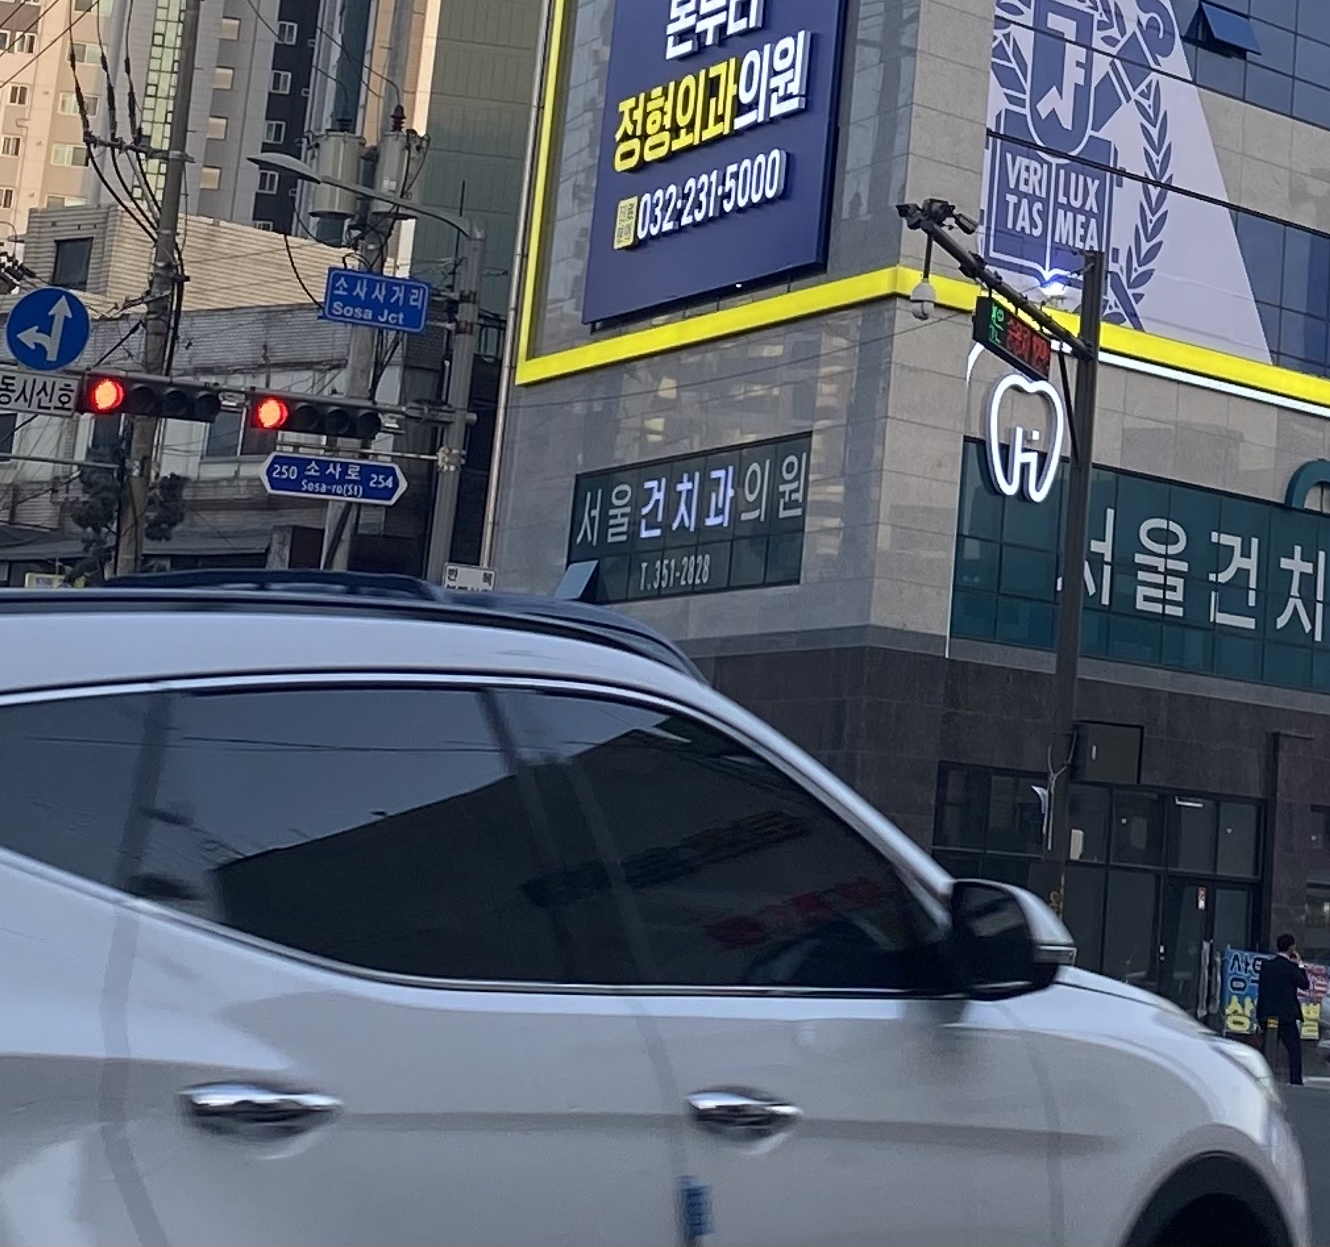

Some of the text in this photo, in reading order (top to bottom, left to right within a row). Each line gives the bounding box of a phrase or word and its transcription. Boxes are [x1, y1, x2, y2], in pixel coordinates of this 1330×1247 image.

[613, 30, 809, 172] 정형외과의원
[1004, 152, 1048, 200] VERI
[1058, 168, 1100, 214] LUX
[1004, 194, 1045, 239] TAS
[1054, 211, 1100, 252] MEA
[331, 300, 405, 325] Sosa Jct
[332, 276, 424, 310] 소사사거리
[0, 375, 75, 412] 동시신호
[272, 460, 394, 489] 250 소사로 254
[576, 452, 807, 547] 서울건치과의원
